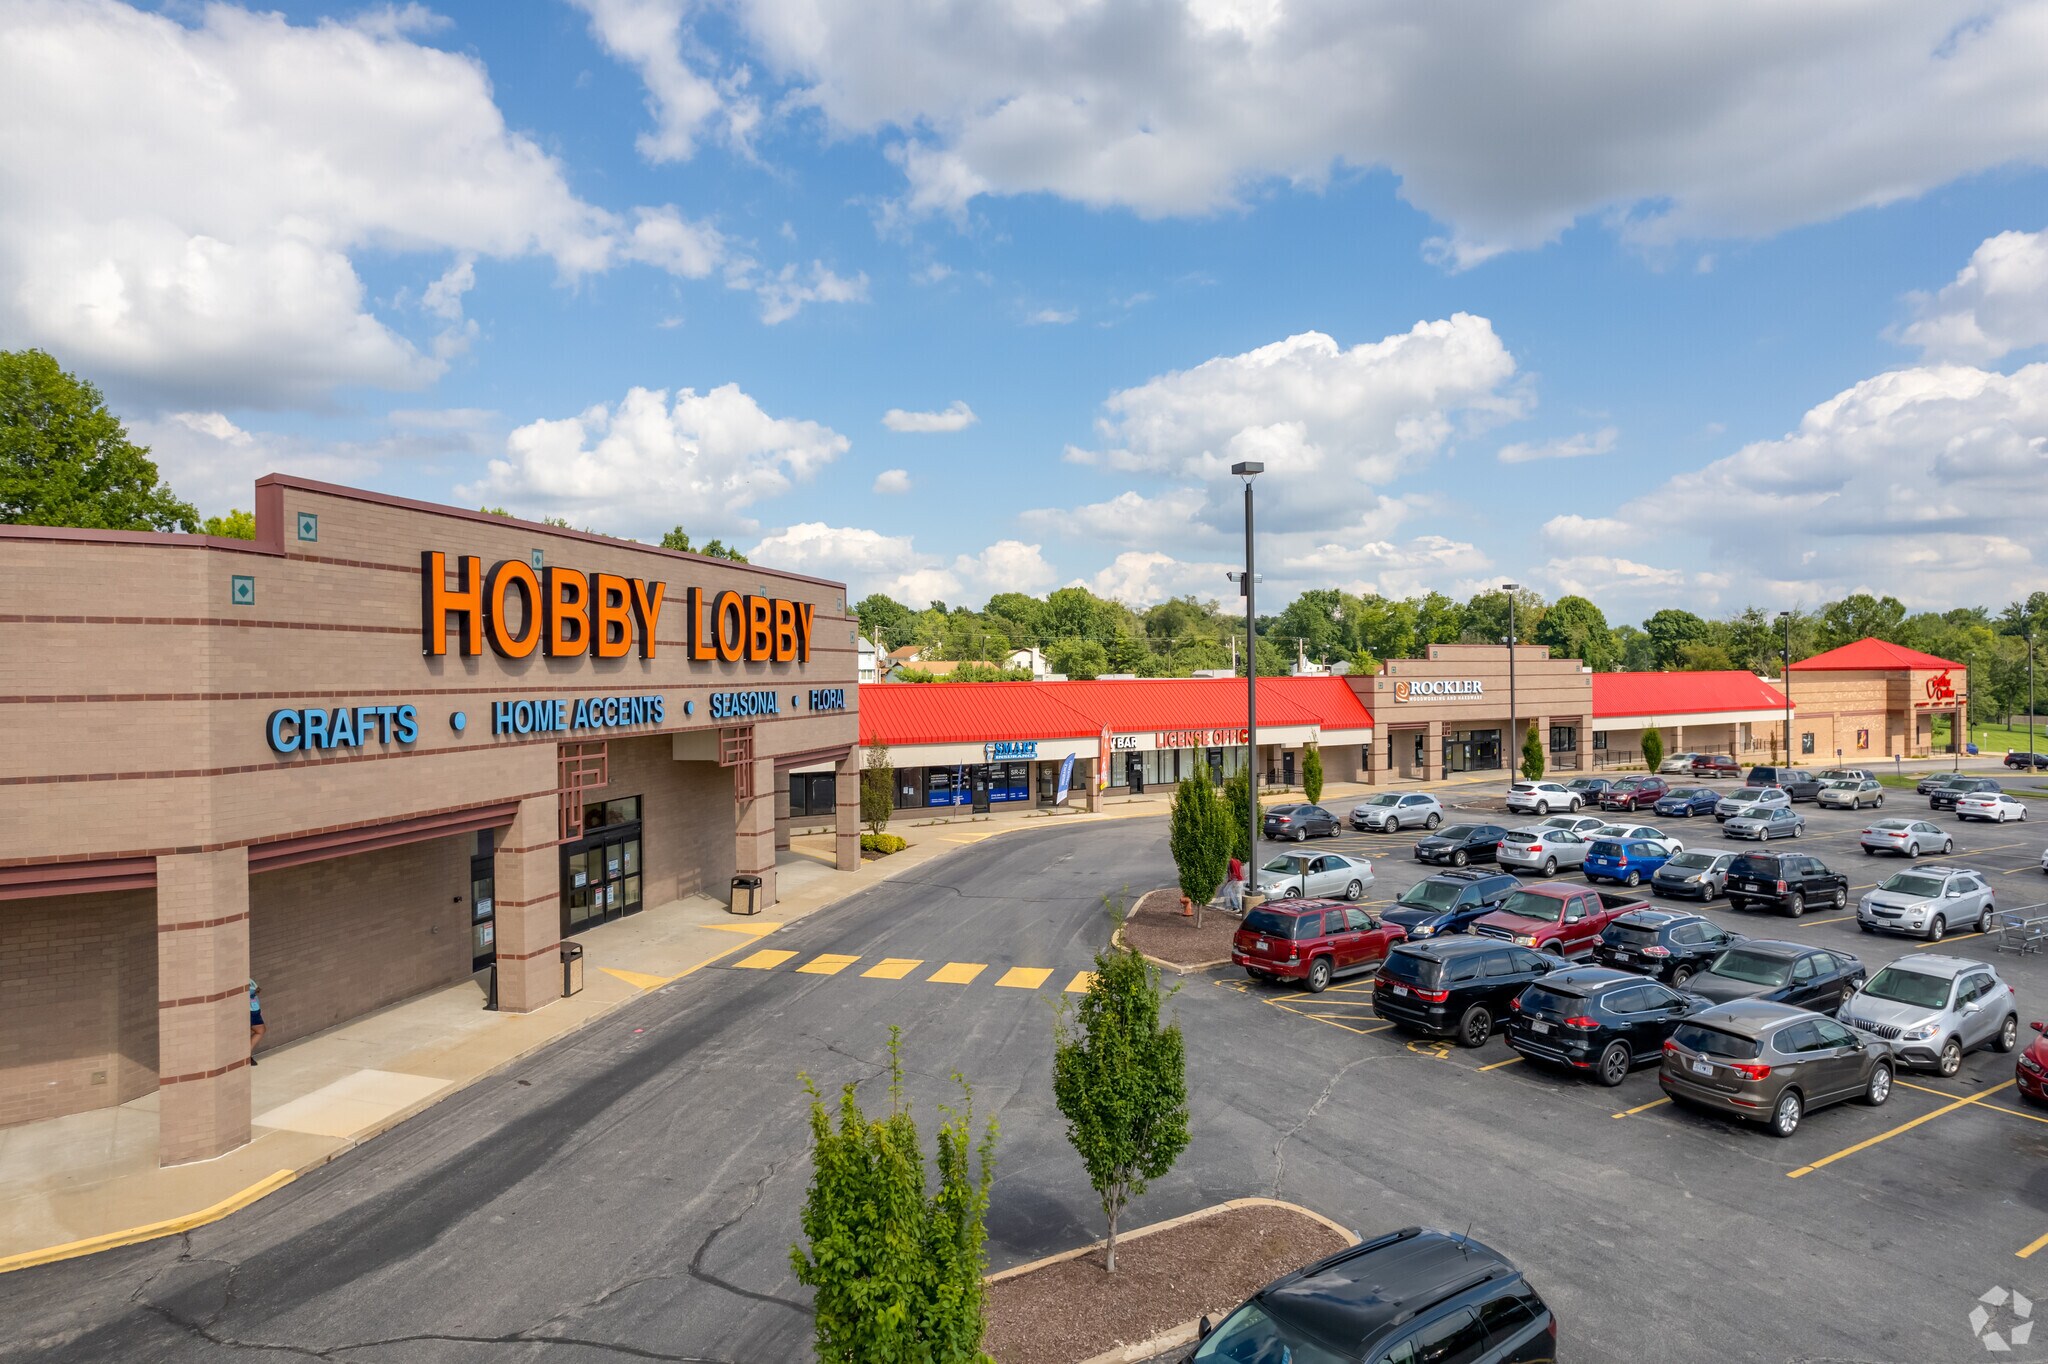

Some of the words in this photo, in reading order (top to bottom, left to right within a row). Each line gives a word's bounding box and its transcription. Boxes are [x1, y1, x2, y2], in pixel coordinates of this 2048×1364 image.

[421, 550, 667, 660] HOBBY
[687, 586, 816, 664] LOBBY
[1409, 680, 1483, 695] ROCKLER
[267, 704, 418, 753] CRAFTS
[491, 699, 567, 735] HOME
[574, 695, 665, 730] ACCENTS
[709, 691, 781, 719] SEASONAL
[809, 688, 847, 711] FLORAL
[1116, 736, 1137, 749] BAR
[1155, 731, 1210, 748] LICENSE
[1212, 728, 1249, 745] OFFIC
[994, 741, 1037, 754] SMART
